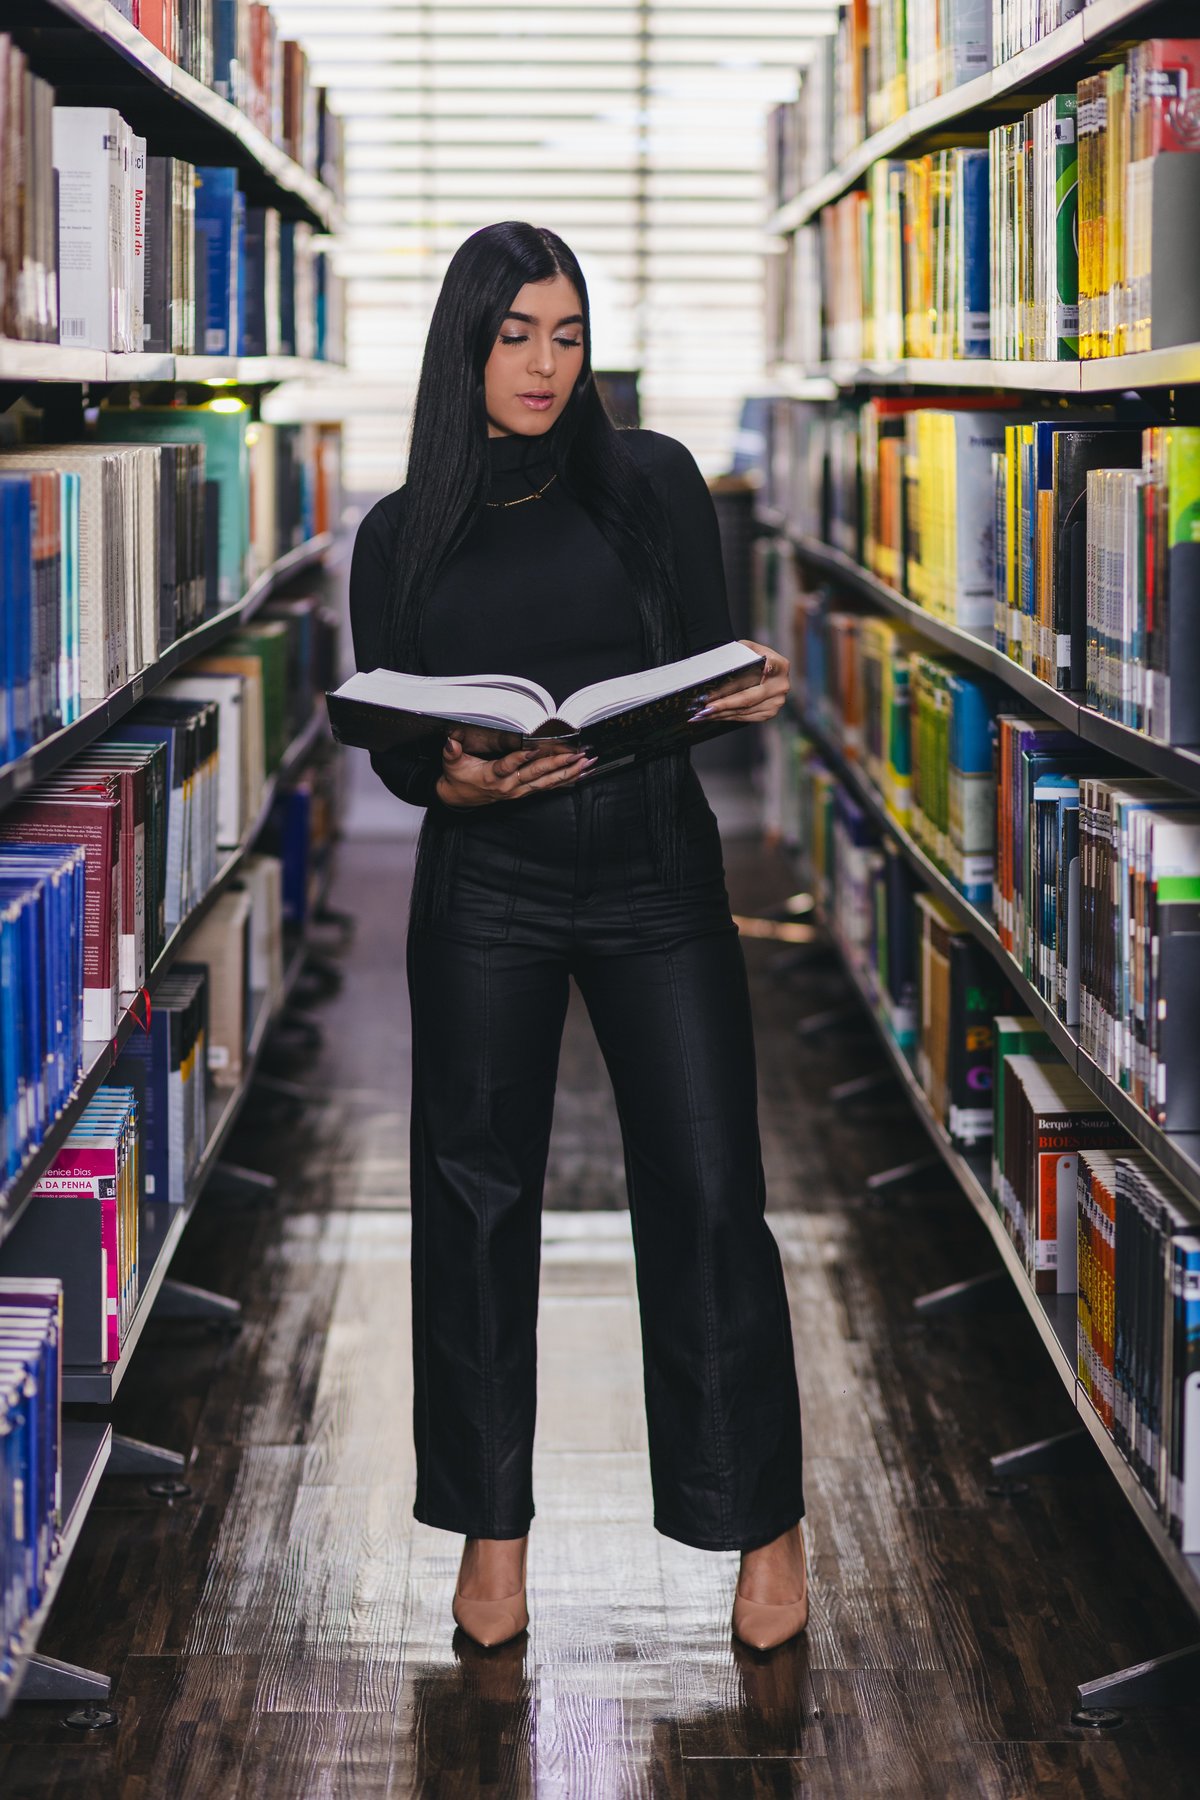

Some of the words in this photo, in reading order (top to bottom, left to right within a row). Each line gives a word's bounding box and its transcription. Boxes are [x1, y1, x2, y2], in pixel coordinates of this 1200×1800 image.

[135, 190, 143, 237] Manual
[135, 240, 142, 256] de
[1038, 1119, 1072, 1130] Berquó
[1080, 1120, 1110, 1128] Souza
